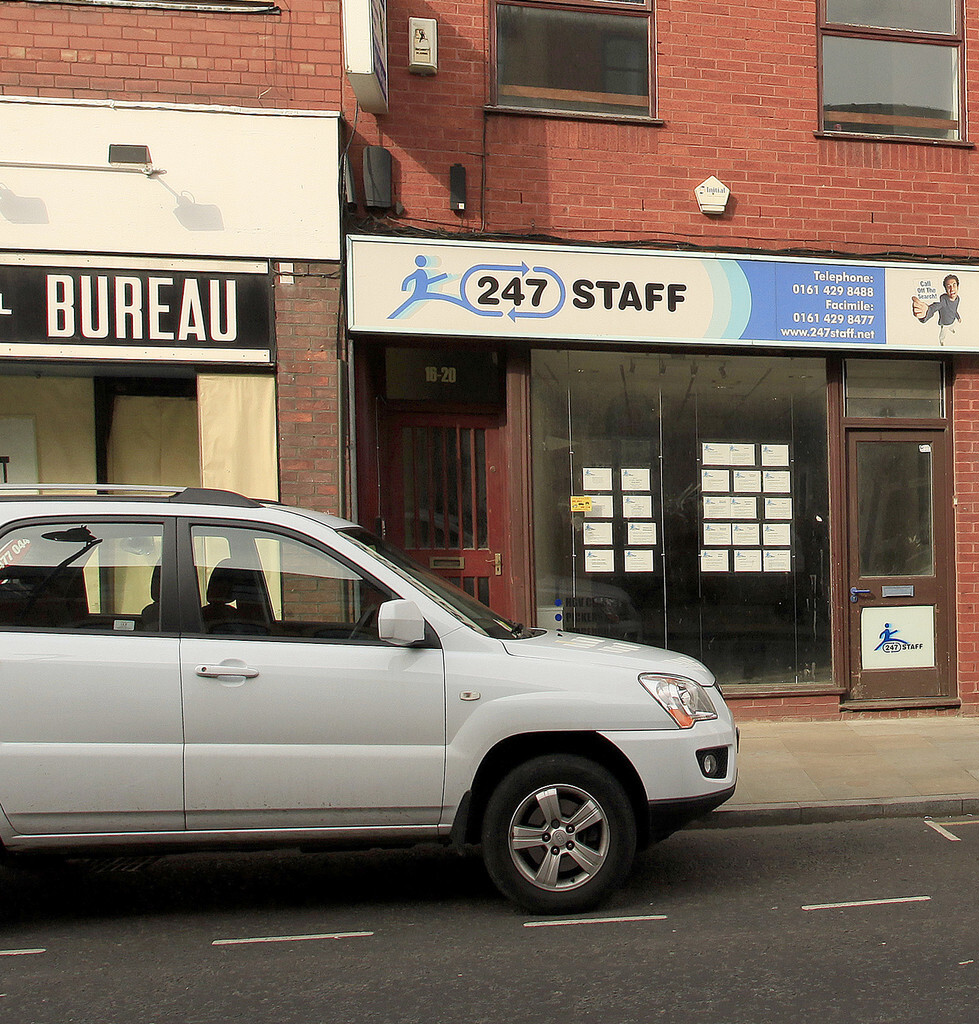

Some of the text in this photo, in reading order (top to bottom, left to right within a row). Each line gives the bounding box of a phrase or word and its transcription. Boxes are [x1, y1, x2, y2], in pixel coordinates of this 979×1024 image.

[813, 270, 874, 284] Telephone:
[477, 276, 687, 312] 247 STAFF
[792, 284, 874, 297] 0161 429 8488
[46, 275, 238, 342] BUREAU
[825, 299, 874, 311] Facimile:
[793, 312, 875, 325] 0161 429 8477
[780, 327, 875, 339] www.247staff.net
